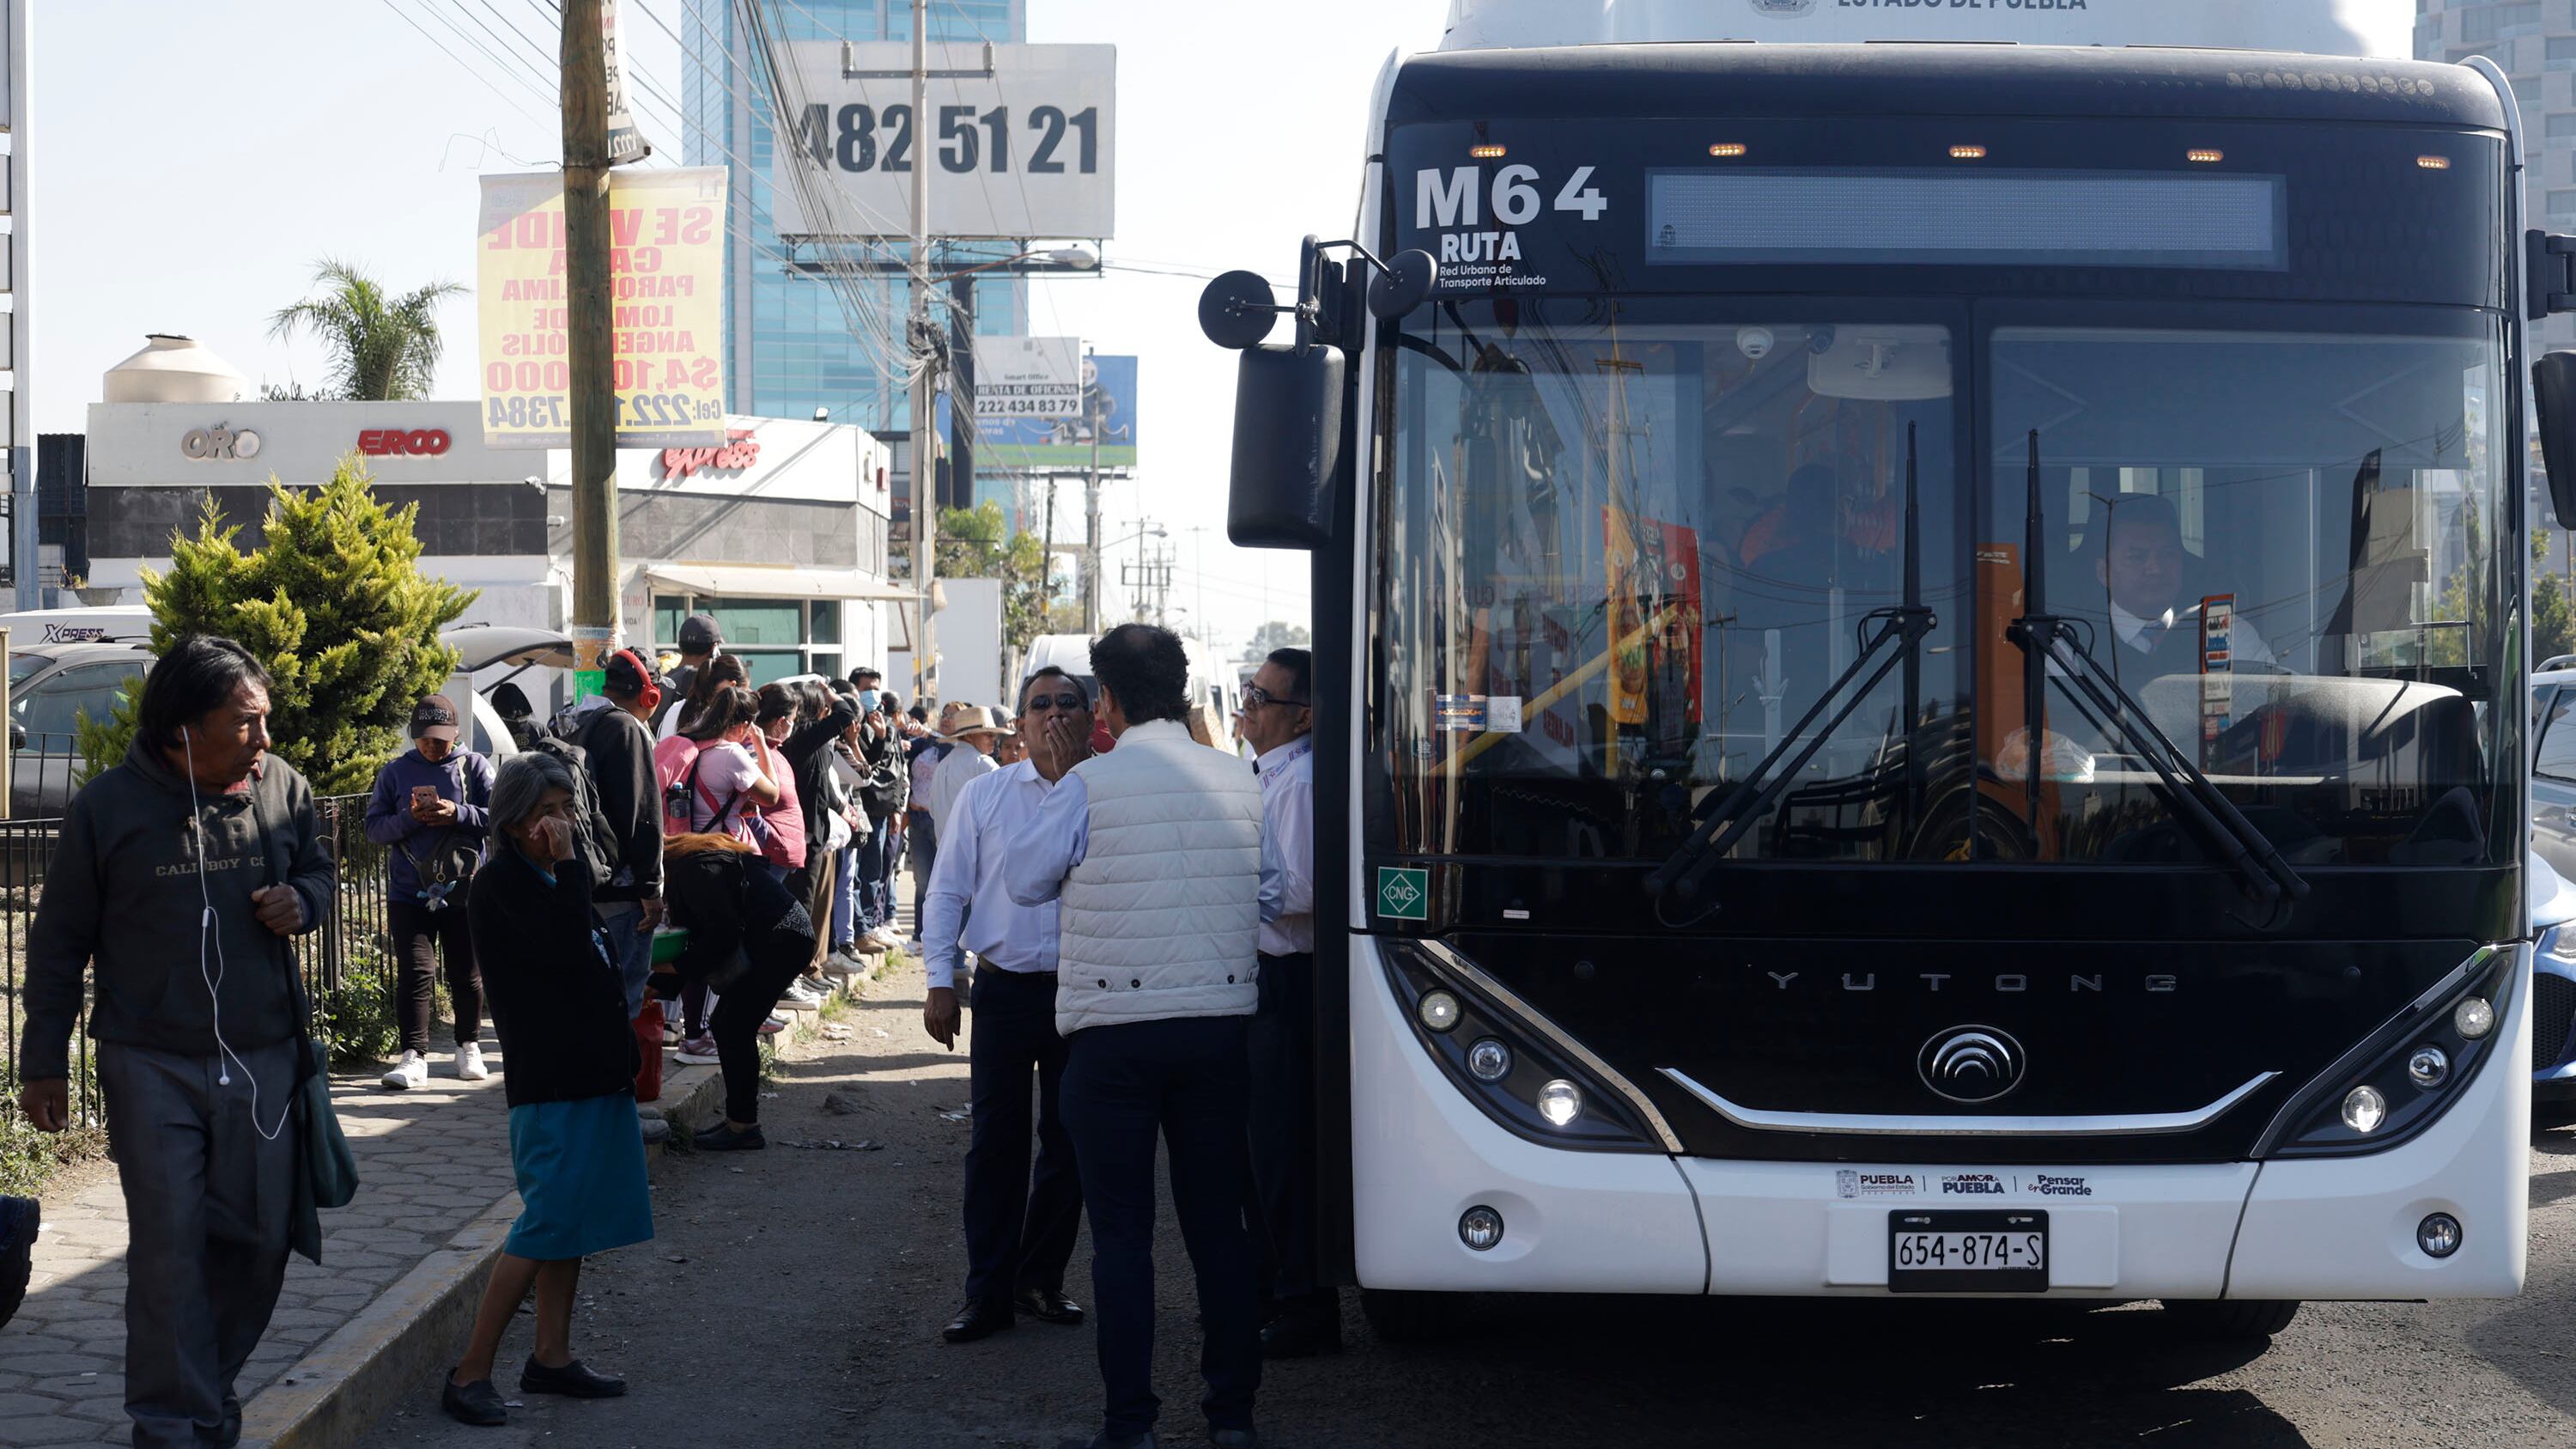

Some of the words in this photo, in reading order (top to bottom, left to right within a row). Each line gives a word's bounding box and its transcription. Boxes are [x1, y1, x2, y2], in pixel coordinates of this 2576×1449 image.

[798, 103, 913, 173] 482
[939, 106, 1008, 174] 51
[1027, 106, 1097, 174] 21
[1441, 231, 1522, 263] RUTA
[1439, 265, 1458, 276] Red
[1460, 265, 1496, 275] Urbana
[1498, 264, 1512, 274] de
[1439, 277, 1492, 289] Transporte
[1494, 275, 1546, 286] Articulado
[1013, 386, 1025, 395] DE
[1030, 385, 1078, 394] OFICINAS
[978, 400, 1005, 412] 222
[1008, 400, 1035, 412] 434
[1038, 399, 1056, 412] 83
[1060, 399, 1078, 411] 79
[356, 429, 452, 456] ERCO
[155, 862, 198, 876] CALI
[207, 858, 241, 871] BOY
[1388, 886, 1413, 901] CNG
[1767, 971, 2177, 992] YUTONG
[1860, 1175, 1914, 1184] PUEBLA
[2037, 1174, 2085, 1185] Pensar
[1942, 1182, 2005, 1194] PUEBLA
[2040, 1184, 2092, 1196] Grande
[1899, 1234, 2040, 1266] 654-874-S
